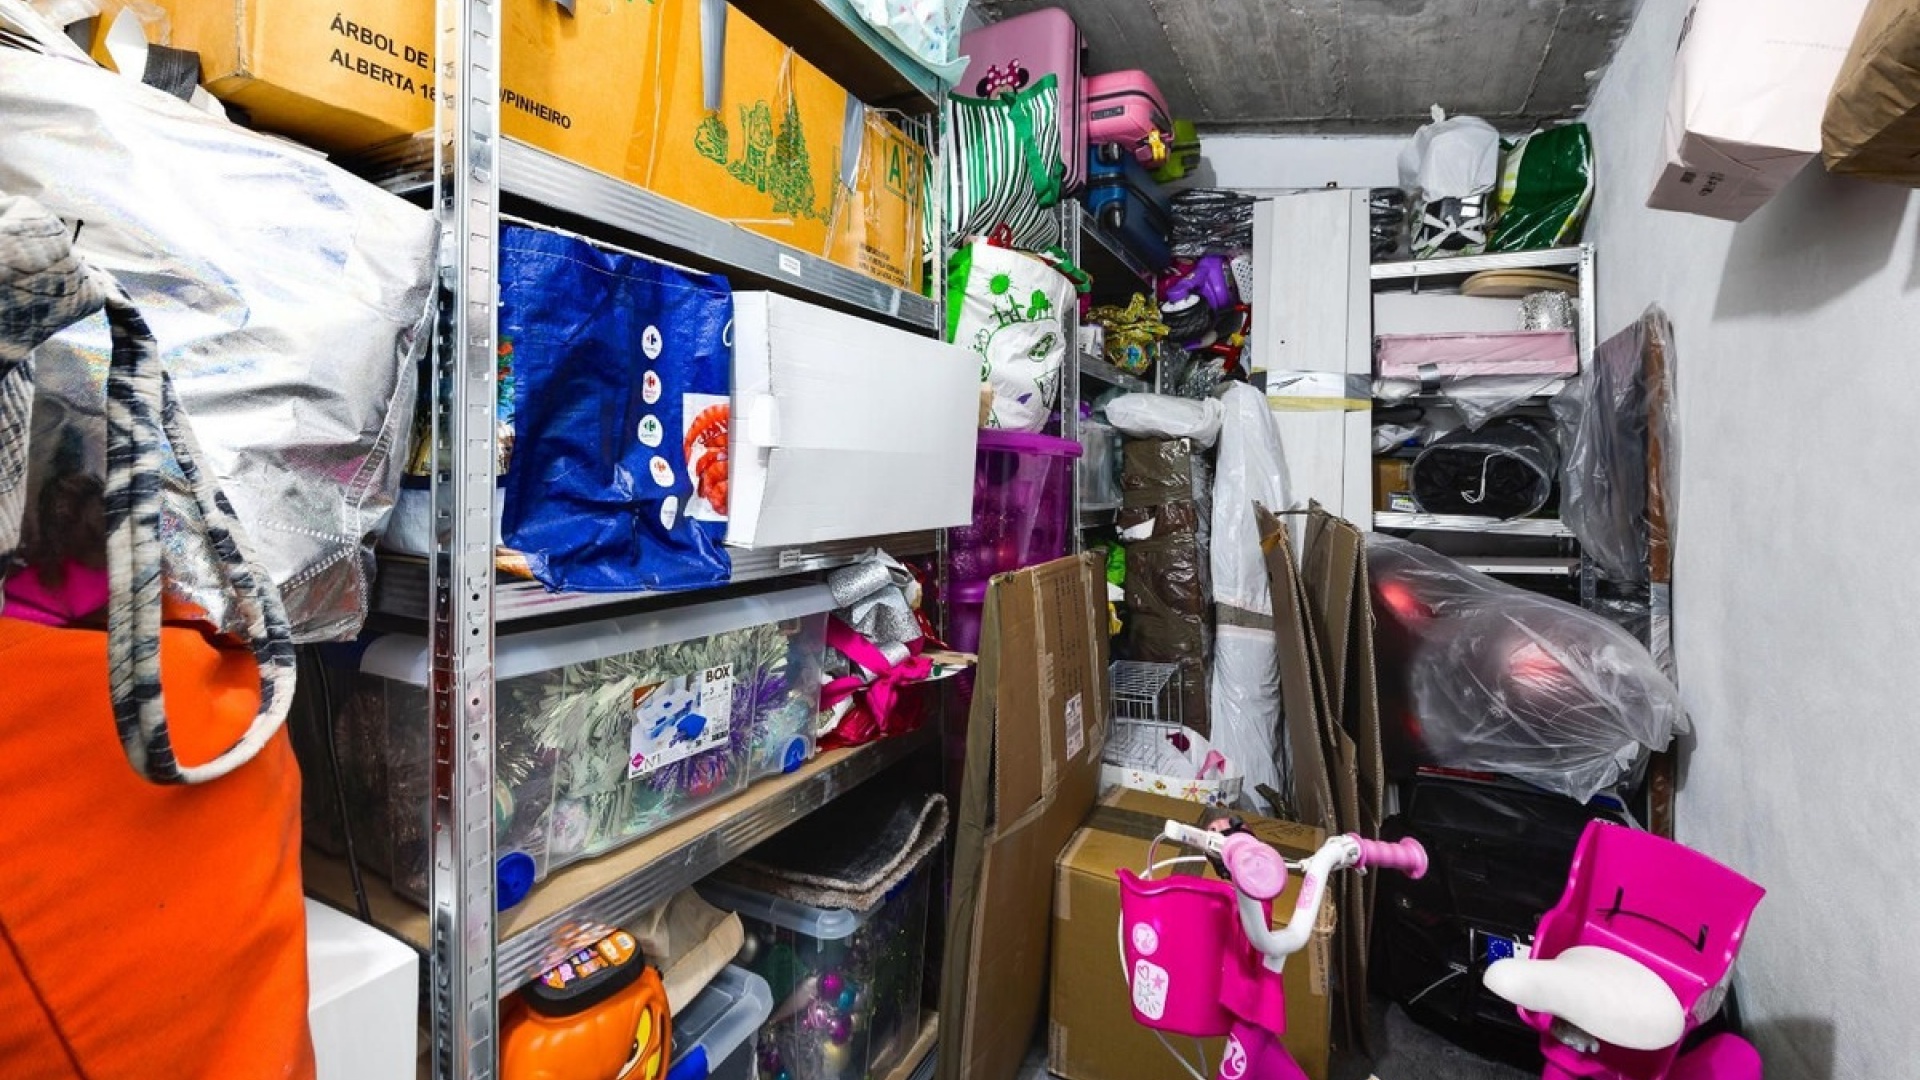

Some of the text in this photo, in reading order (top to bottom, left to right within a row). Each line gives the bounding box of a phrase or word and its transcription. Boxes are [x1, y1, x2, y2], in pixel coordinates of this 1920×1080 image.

[330, 12, 399, 58] ÁRBOL
[404, 45, 428, 69] DE
[330, 48, 415, 95] ALBERTA
[706, 664, 730, 683] BOX
